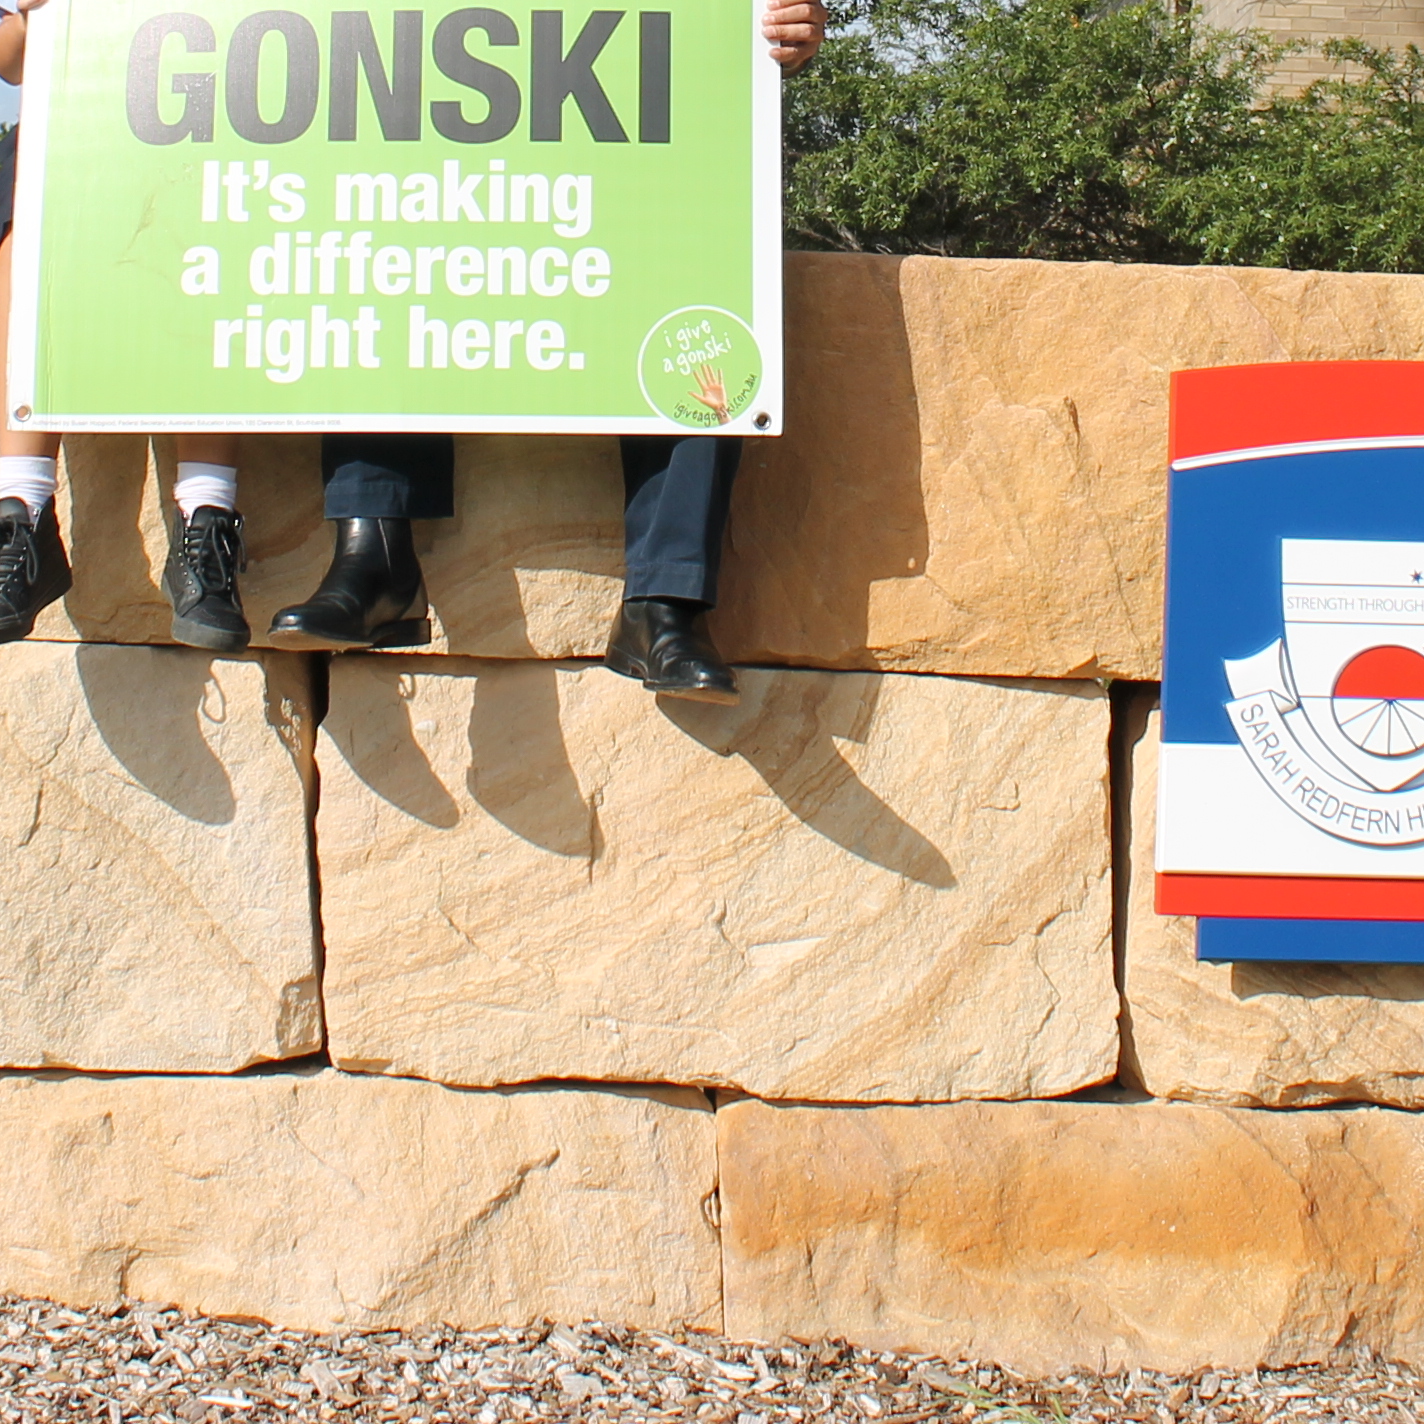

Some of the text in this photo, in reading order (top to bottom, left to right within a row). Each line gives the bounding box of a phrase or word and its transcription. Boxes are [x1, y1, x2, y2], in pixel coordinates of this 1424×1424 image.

[125, 8, 672, 145] GONSKI
[200, 159, 594, 238] It's making
[180, 232, 612, 298] a difference
[213, 304, 586, 384] right here.
[662, 331, 733, 376] a gonski
[676, 319, 712, 351] give
[1286, 596, 1355, 611] STRENGTH
[1358, 597, 1424, 613] THROUGH
[1240, 703, 1301, 788] SARAH
[1292, 775, 1401, 834] REDFERN
